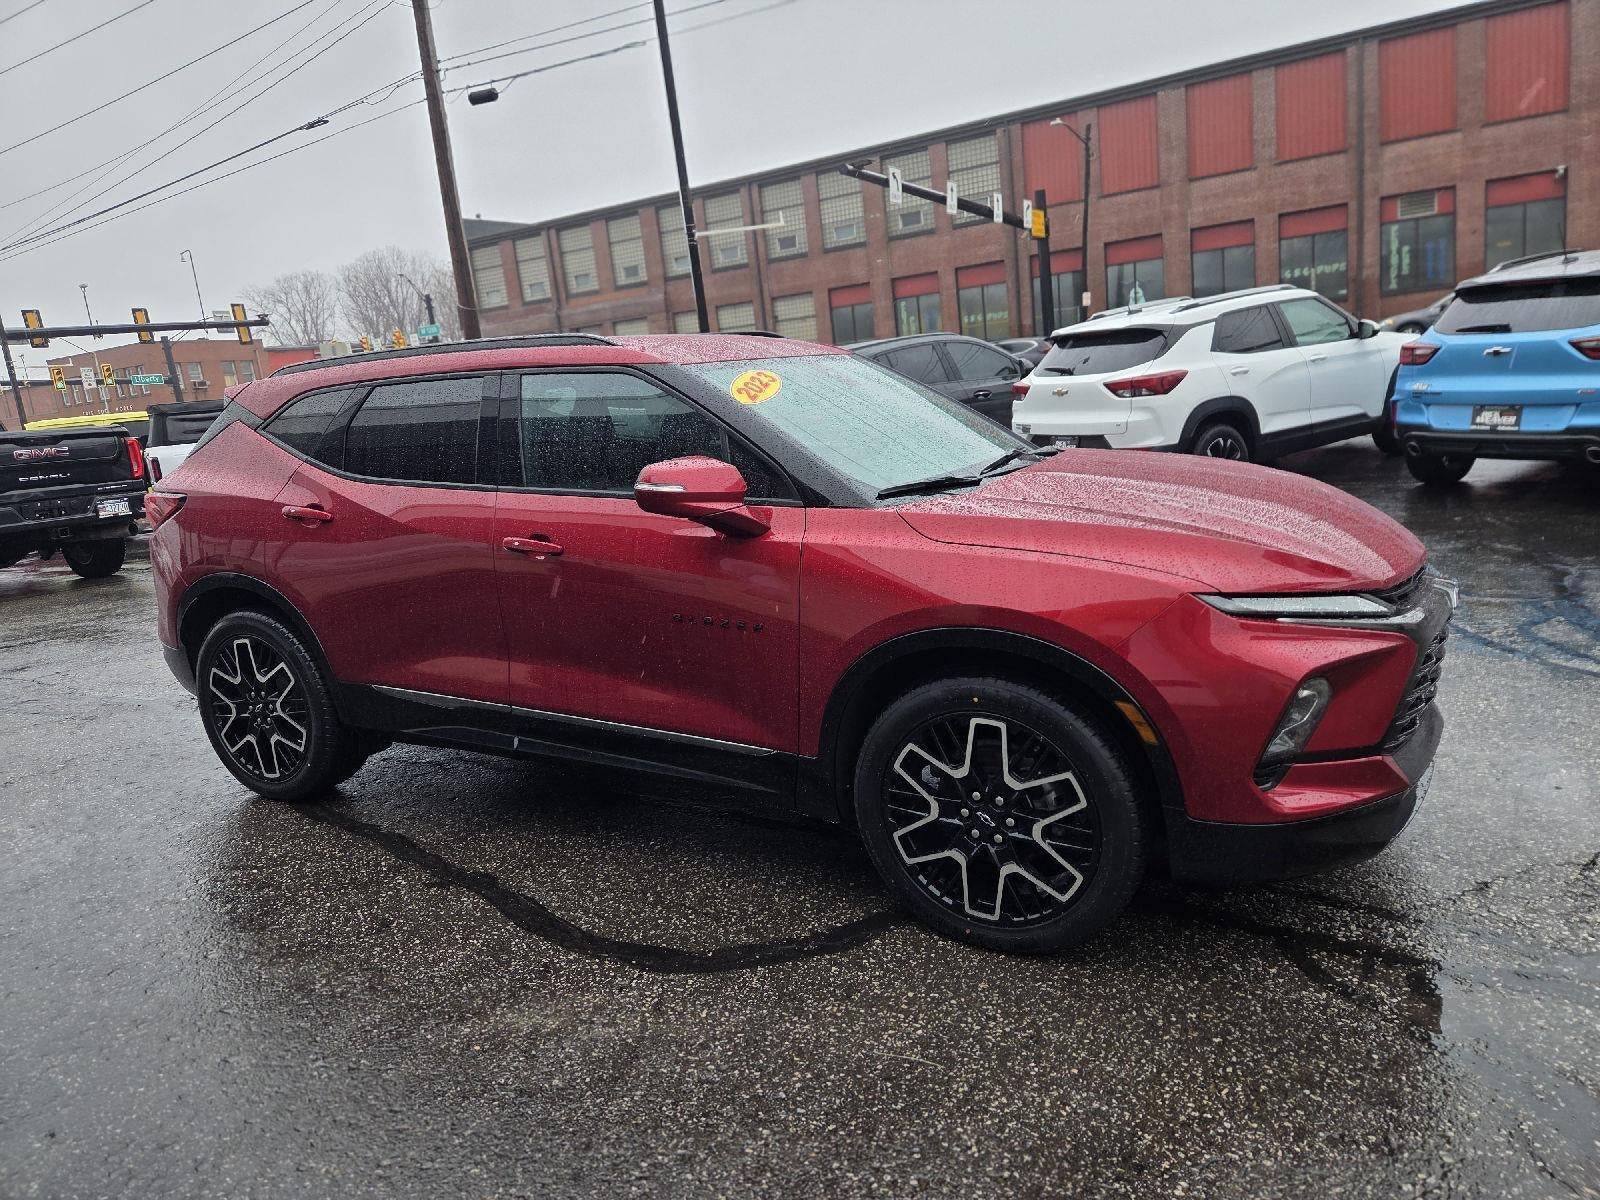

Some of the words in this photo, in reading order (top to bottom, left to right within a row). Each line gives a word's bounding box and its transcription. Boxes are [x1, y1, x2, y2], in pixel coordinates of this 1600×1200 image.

[134, 375, 159, 383] Liberty
[737, 371, 778, 401] 2023
[1475, 415, 1517, 425] WEAVER
[13, 446, 69, 460] GMC
[672, 613, 764, 633] BLAZER
